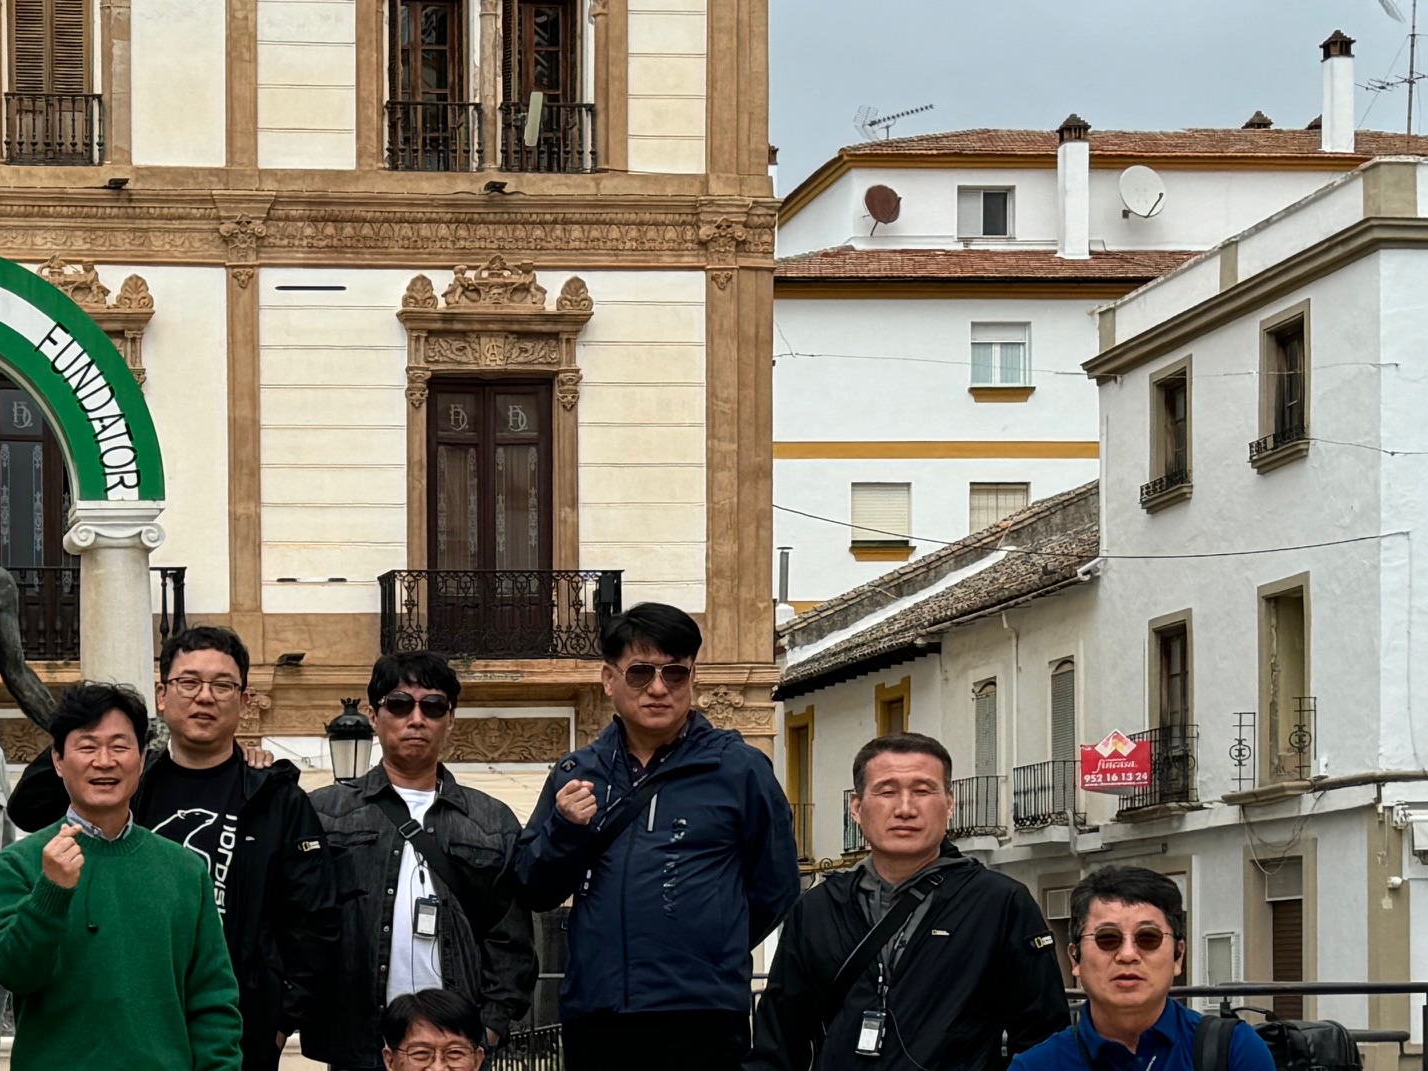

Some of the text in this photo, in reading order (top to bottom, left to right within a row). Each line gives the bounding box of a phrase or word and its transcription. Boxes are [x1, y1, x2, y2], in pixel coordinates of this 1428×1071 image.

[34, 321, 141, 493] FUNDATOR
[1084, 771, 1148, 783] 952 16 13 24
